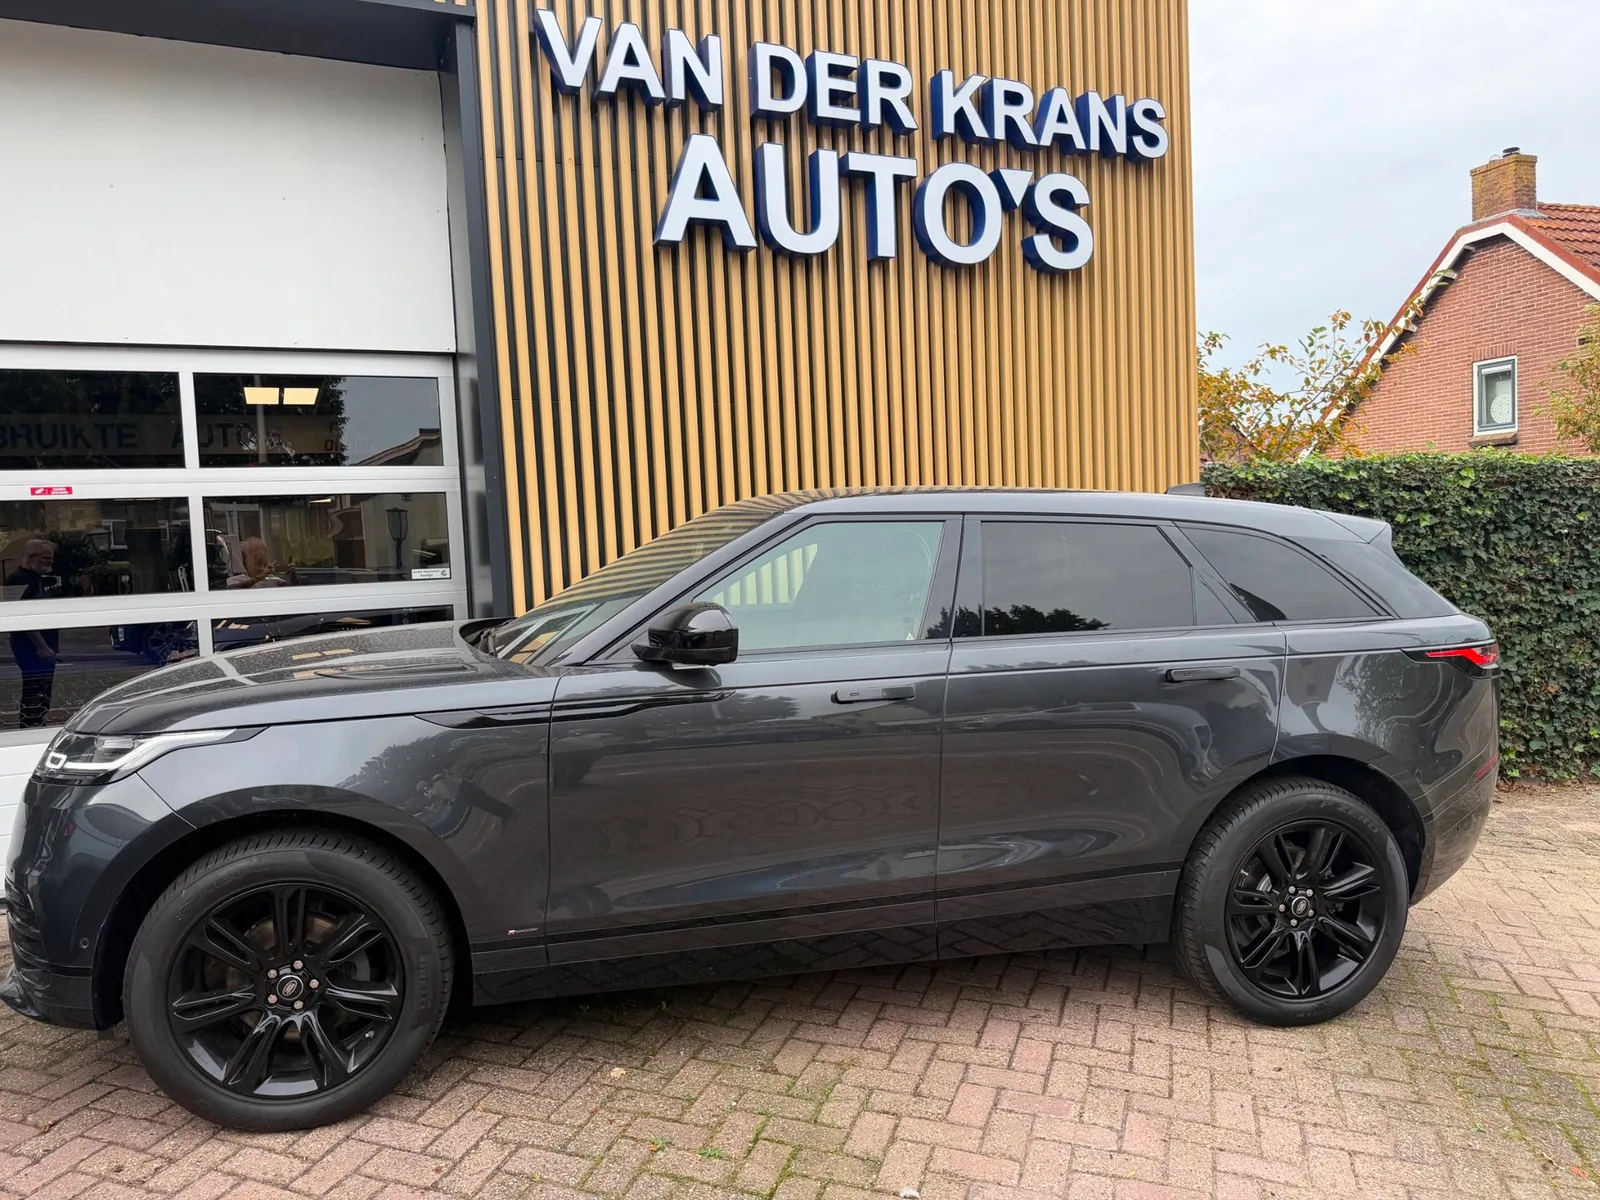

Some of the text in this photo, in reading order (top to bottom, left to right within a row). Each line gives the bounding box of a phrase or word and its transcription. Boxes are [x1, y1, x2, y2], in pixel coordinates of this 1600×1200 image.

[534, 9, 1169, 163] VAN DER KRANS
[653, 133, 1095, 272] AUTO'S
